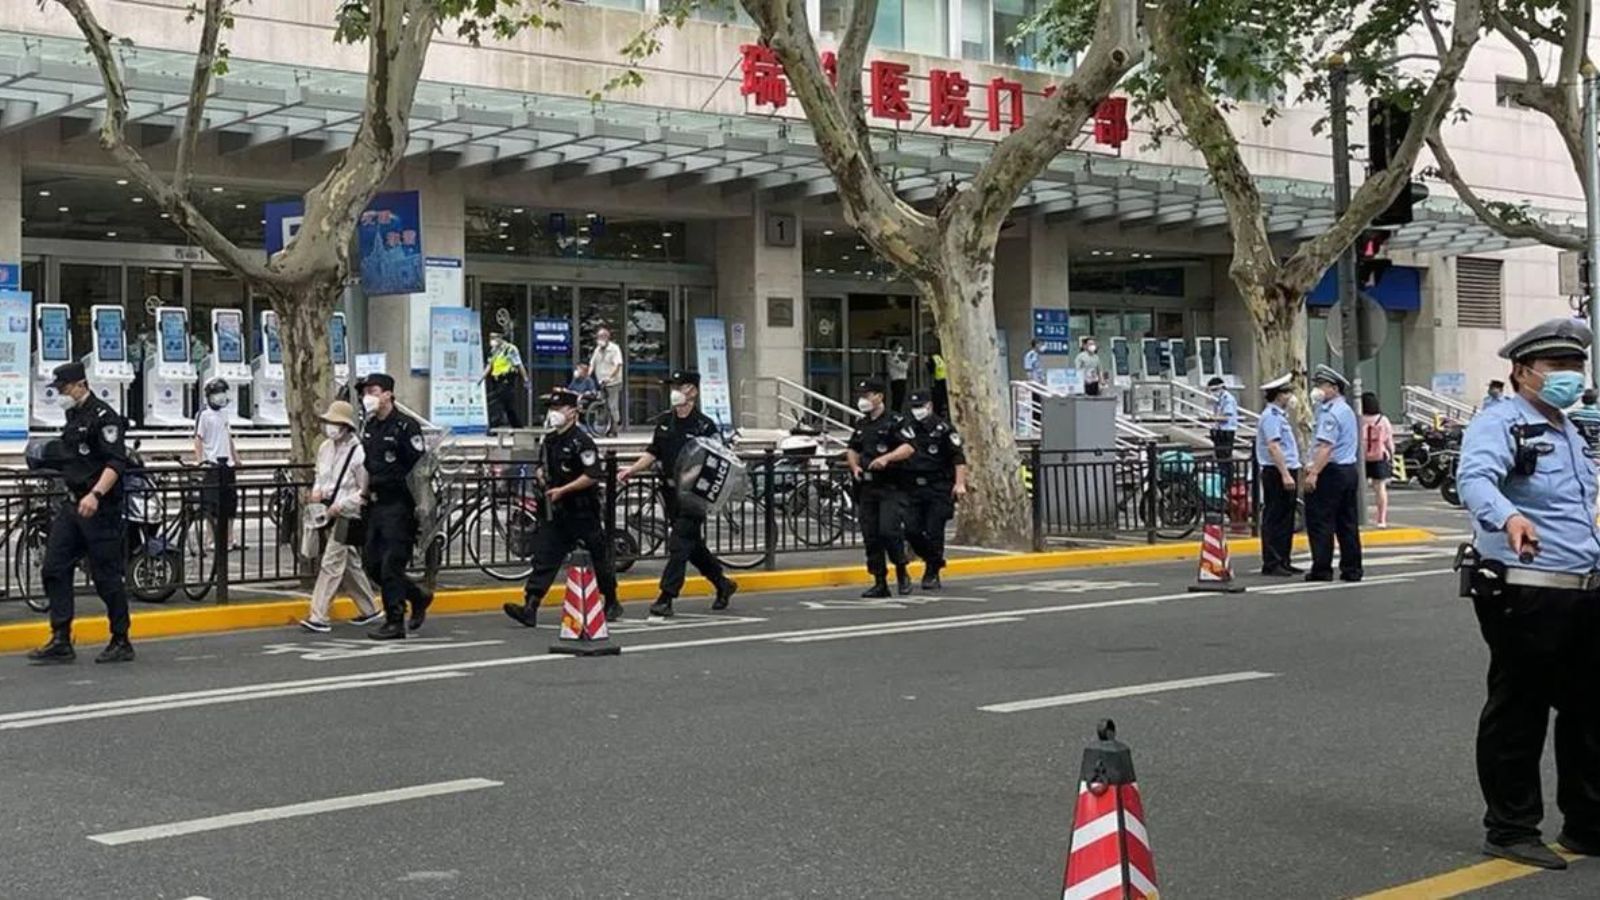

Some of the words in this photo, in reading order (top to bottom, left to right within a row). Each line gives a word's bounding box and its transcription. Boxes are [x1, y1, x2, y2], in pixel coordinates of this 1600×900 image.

[740, 44, 1129, 148] 瑞医院门部
[777, 221, 784, 240] 1
[707, 459, 729, 502] POLICE
